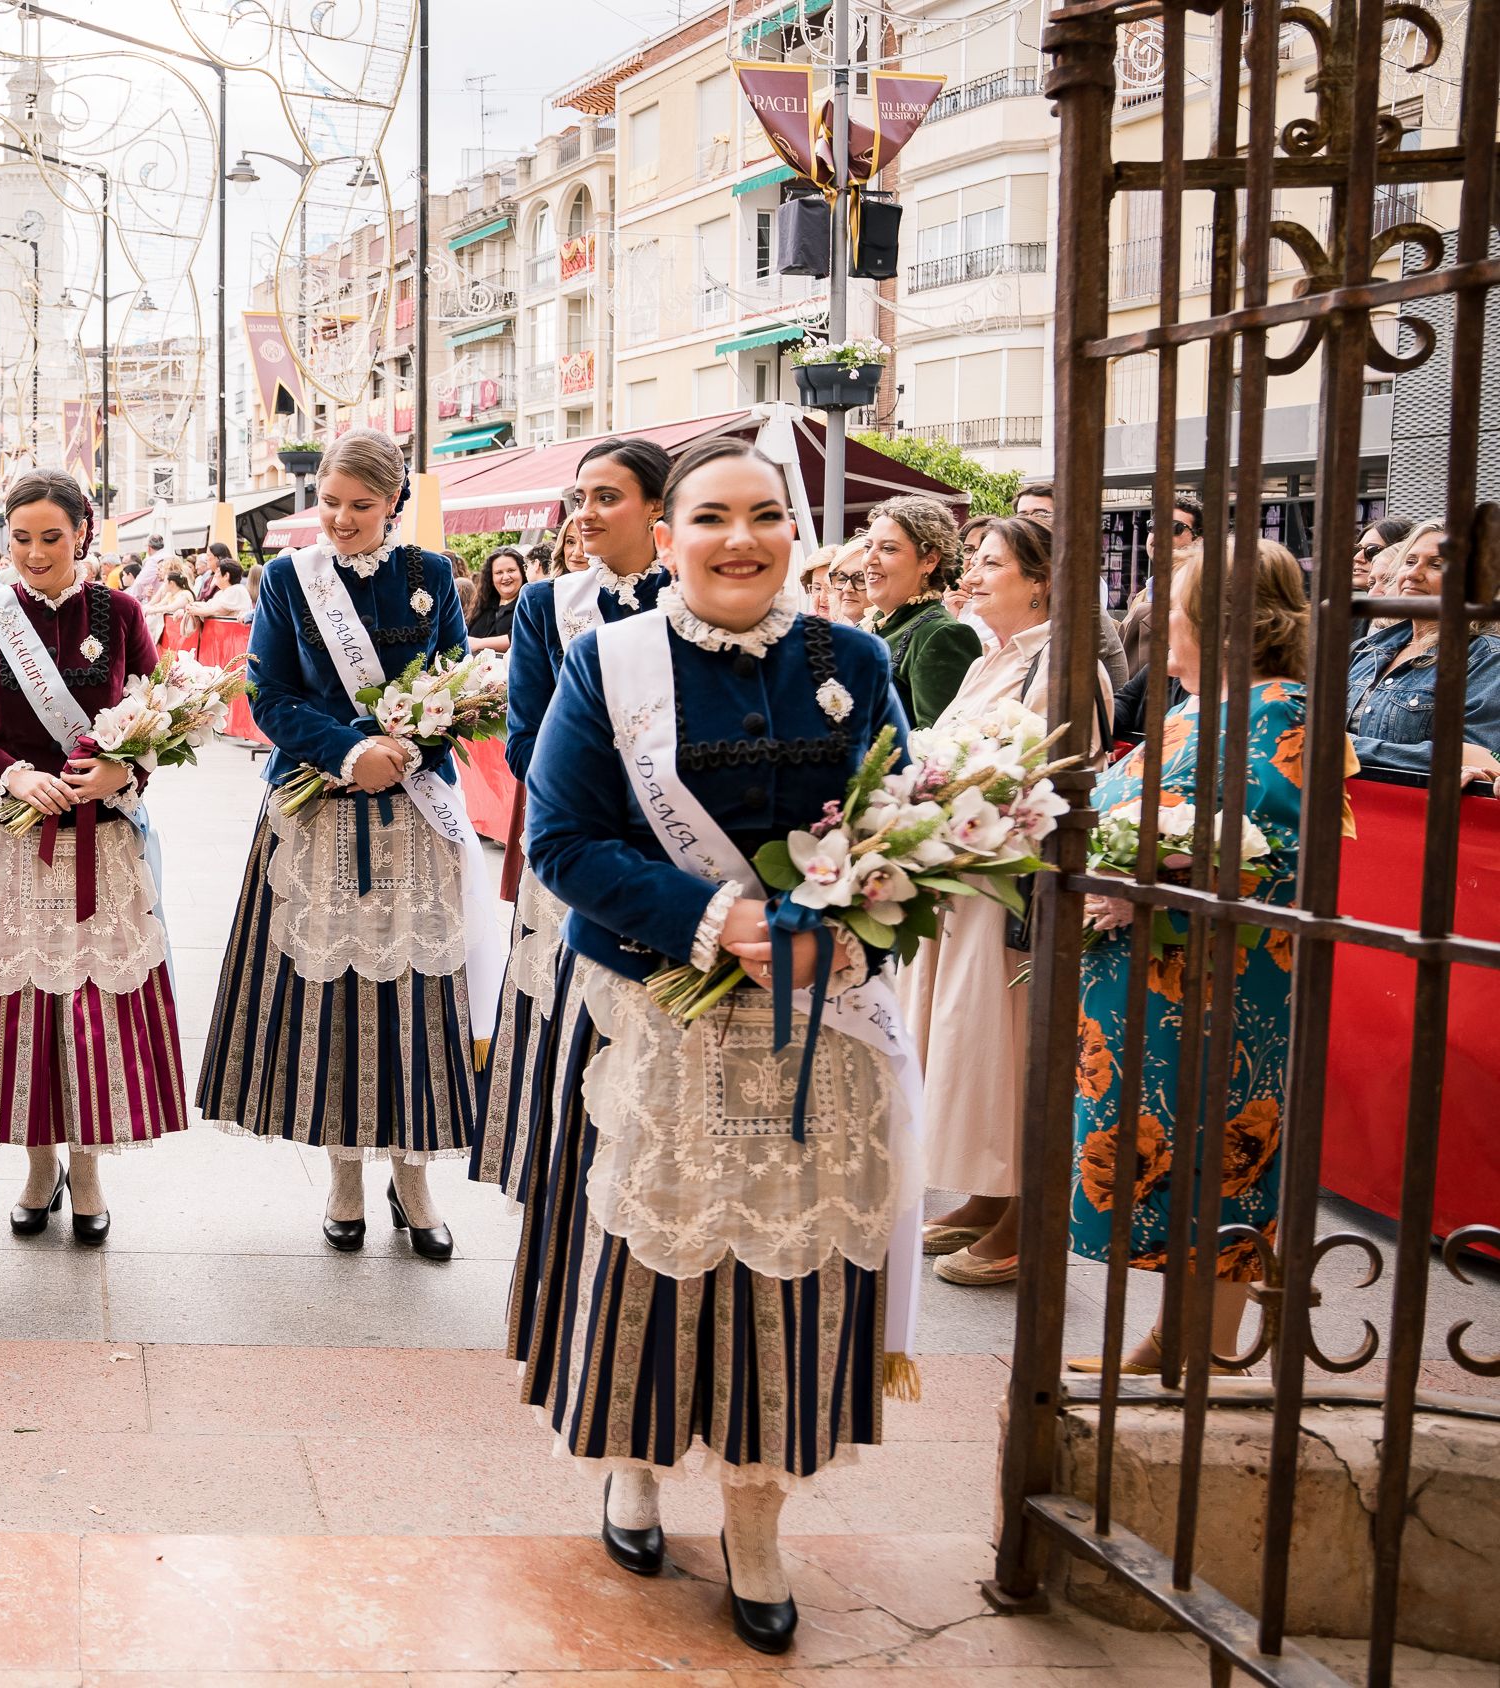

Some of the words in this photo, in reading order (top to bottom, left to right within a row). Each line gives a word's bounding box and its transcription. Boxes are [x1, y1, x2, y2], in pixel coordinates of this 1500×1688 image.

[881, 111, 916, 120] NUESTRO
[326, 609, 365, 667] DAMA
[431, 802, 463, 837] 2026
[635, 755, 699, 854] DAMA
